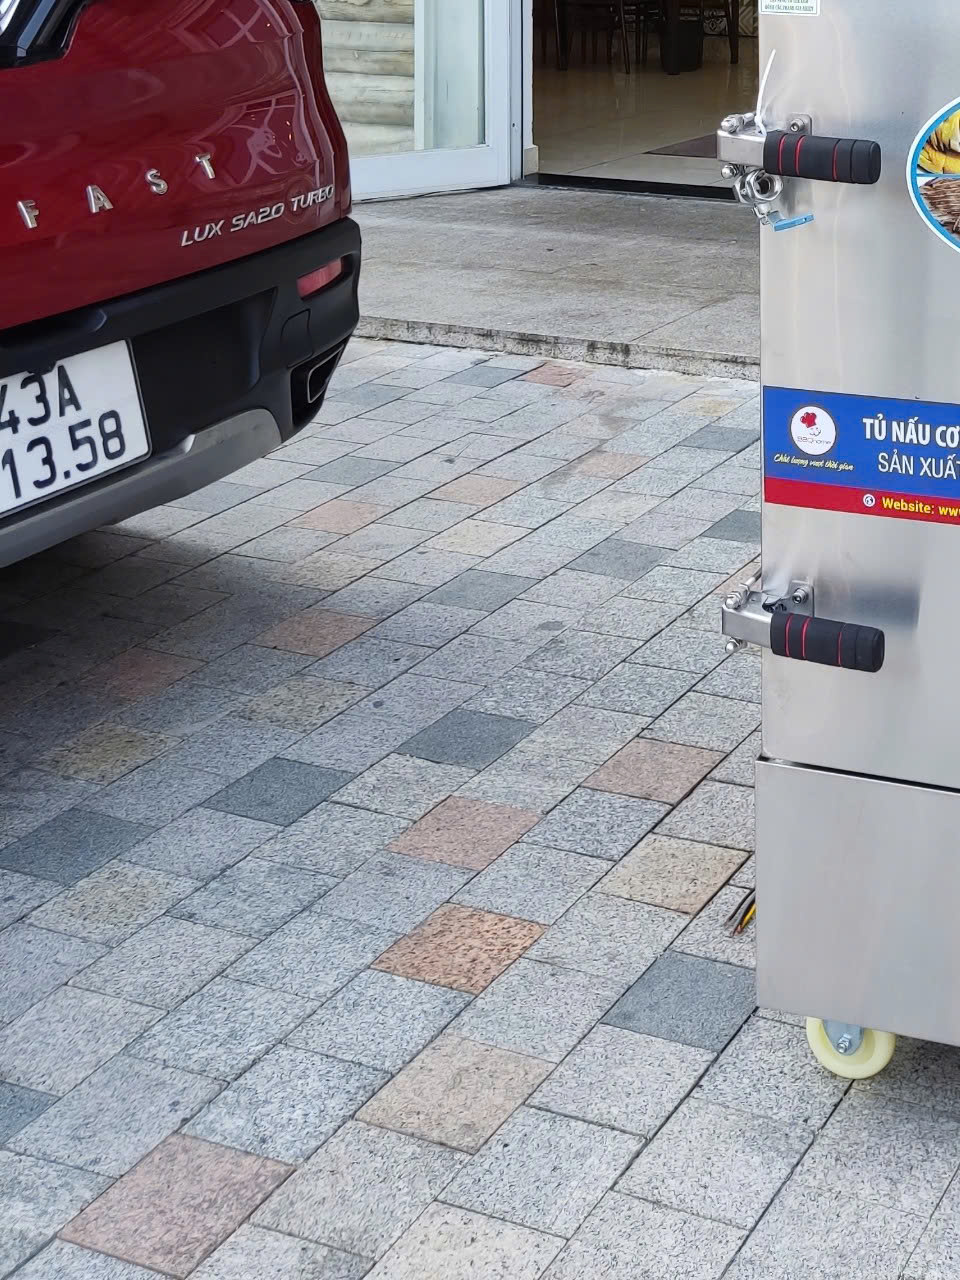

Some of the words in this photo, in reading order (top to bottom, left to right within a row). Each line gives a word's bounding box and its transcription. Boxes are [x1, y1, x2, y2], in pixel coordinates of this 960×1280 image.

[181, 220, 225, 247] LUX
[291, 184, 334, 212] TURBO
[863, 414, 886, 441] TỦ
[891, 417, 931, 445] NẤU
[878, 448, 914, 475] SẢN
[882, 496, 935, 515] Website:
